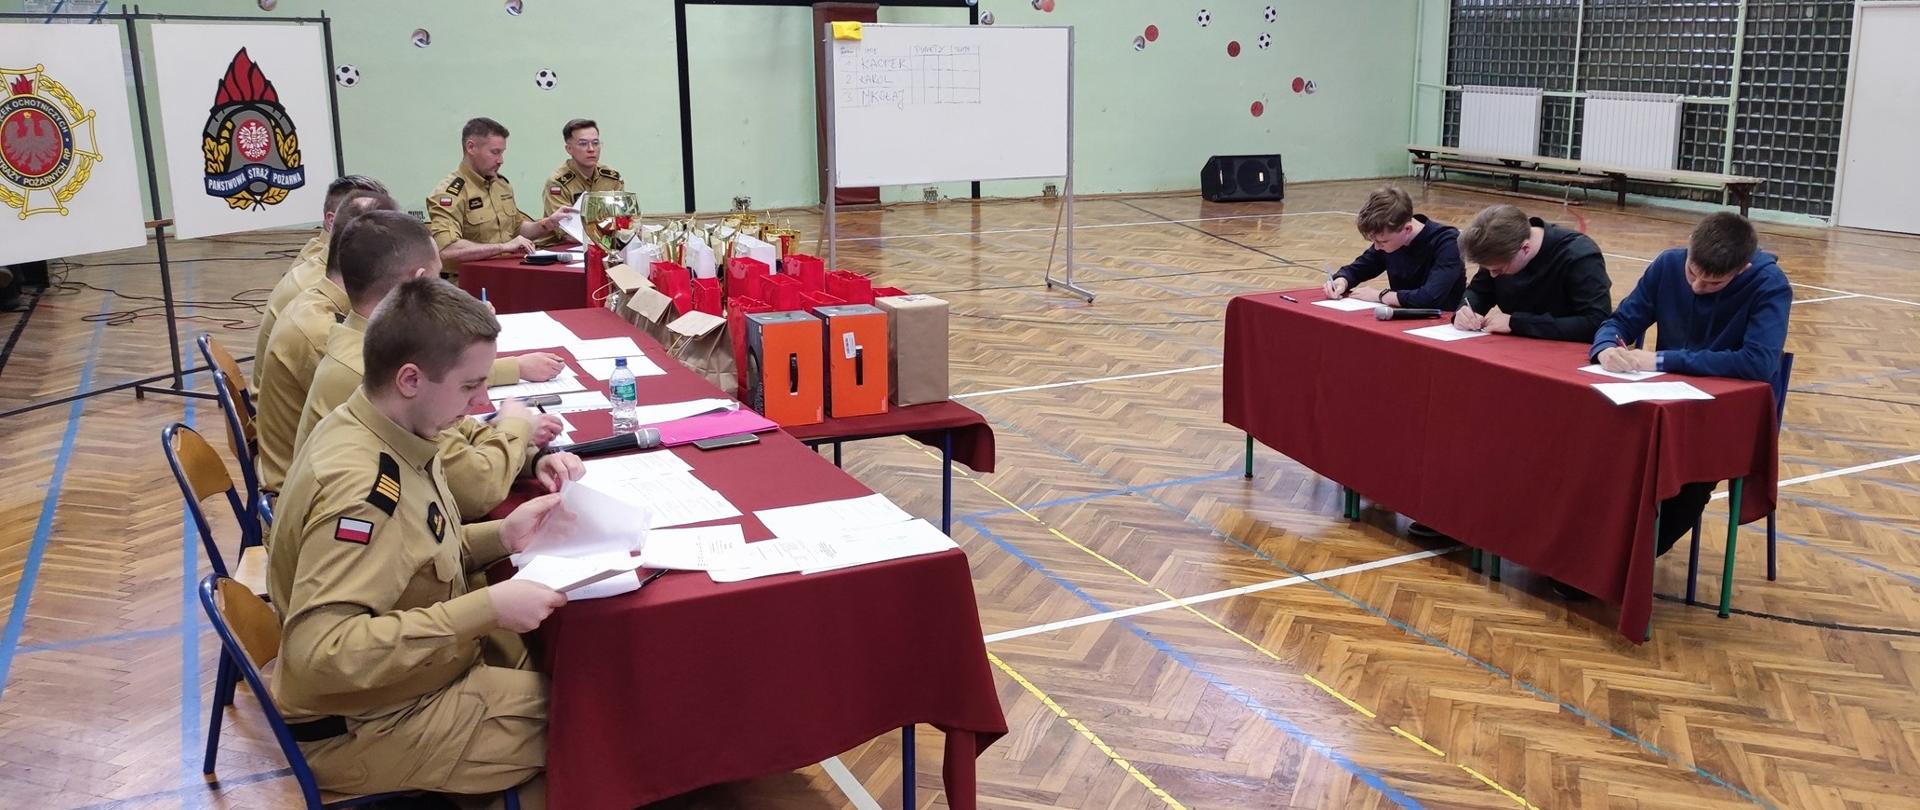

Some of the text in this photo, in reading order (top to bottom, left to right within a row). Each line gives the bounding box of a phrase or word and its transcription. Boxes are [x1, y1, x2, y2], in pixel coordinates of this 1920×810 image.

[862, 58, 909, 70] KACPER
[845, 73, 893, 84] 2 KAROL
[12, 99, 68, 132] OCHOTNICZYCH
[23, 163, 66, 187] POŻARNYCH
[63, 147, 71, 160] RP
[248, 167, 269, 179] STRAŻ
[272, 172, 302, 185] POŻARNA
